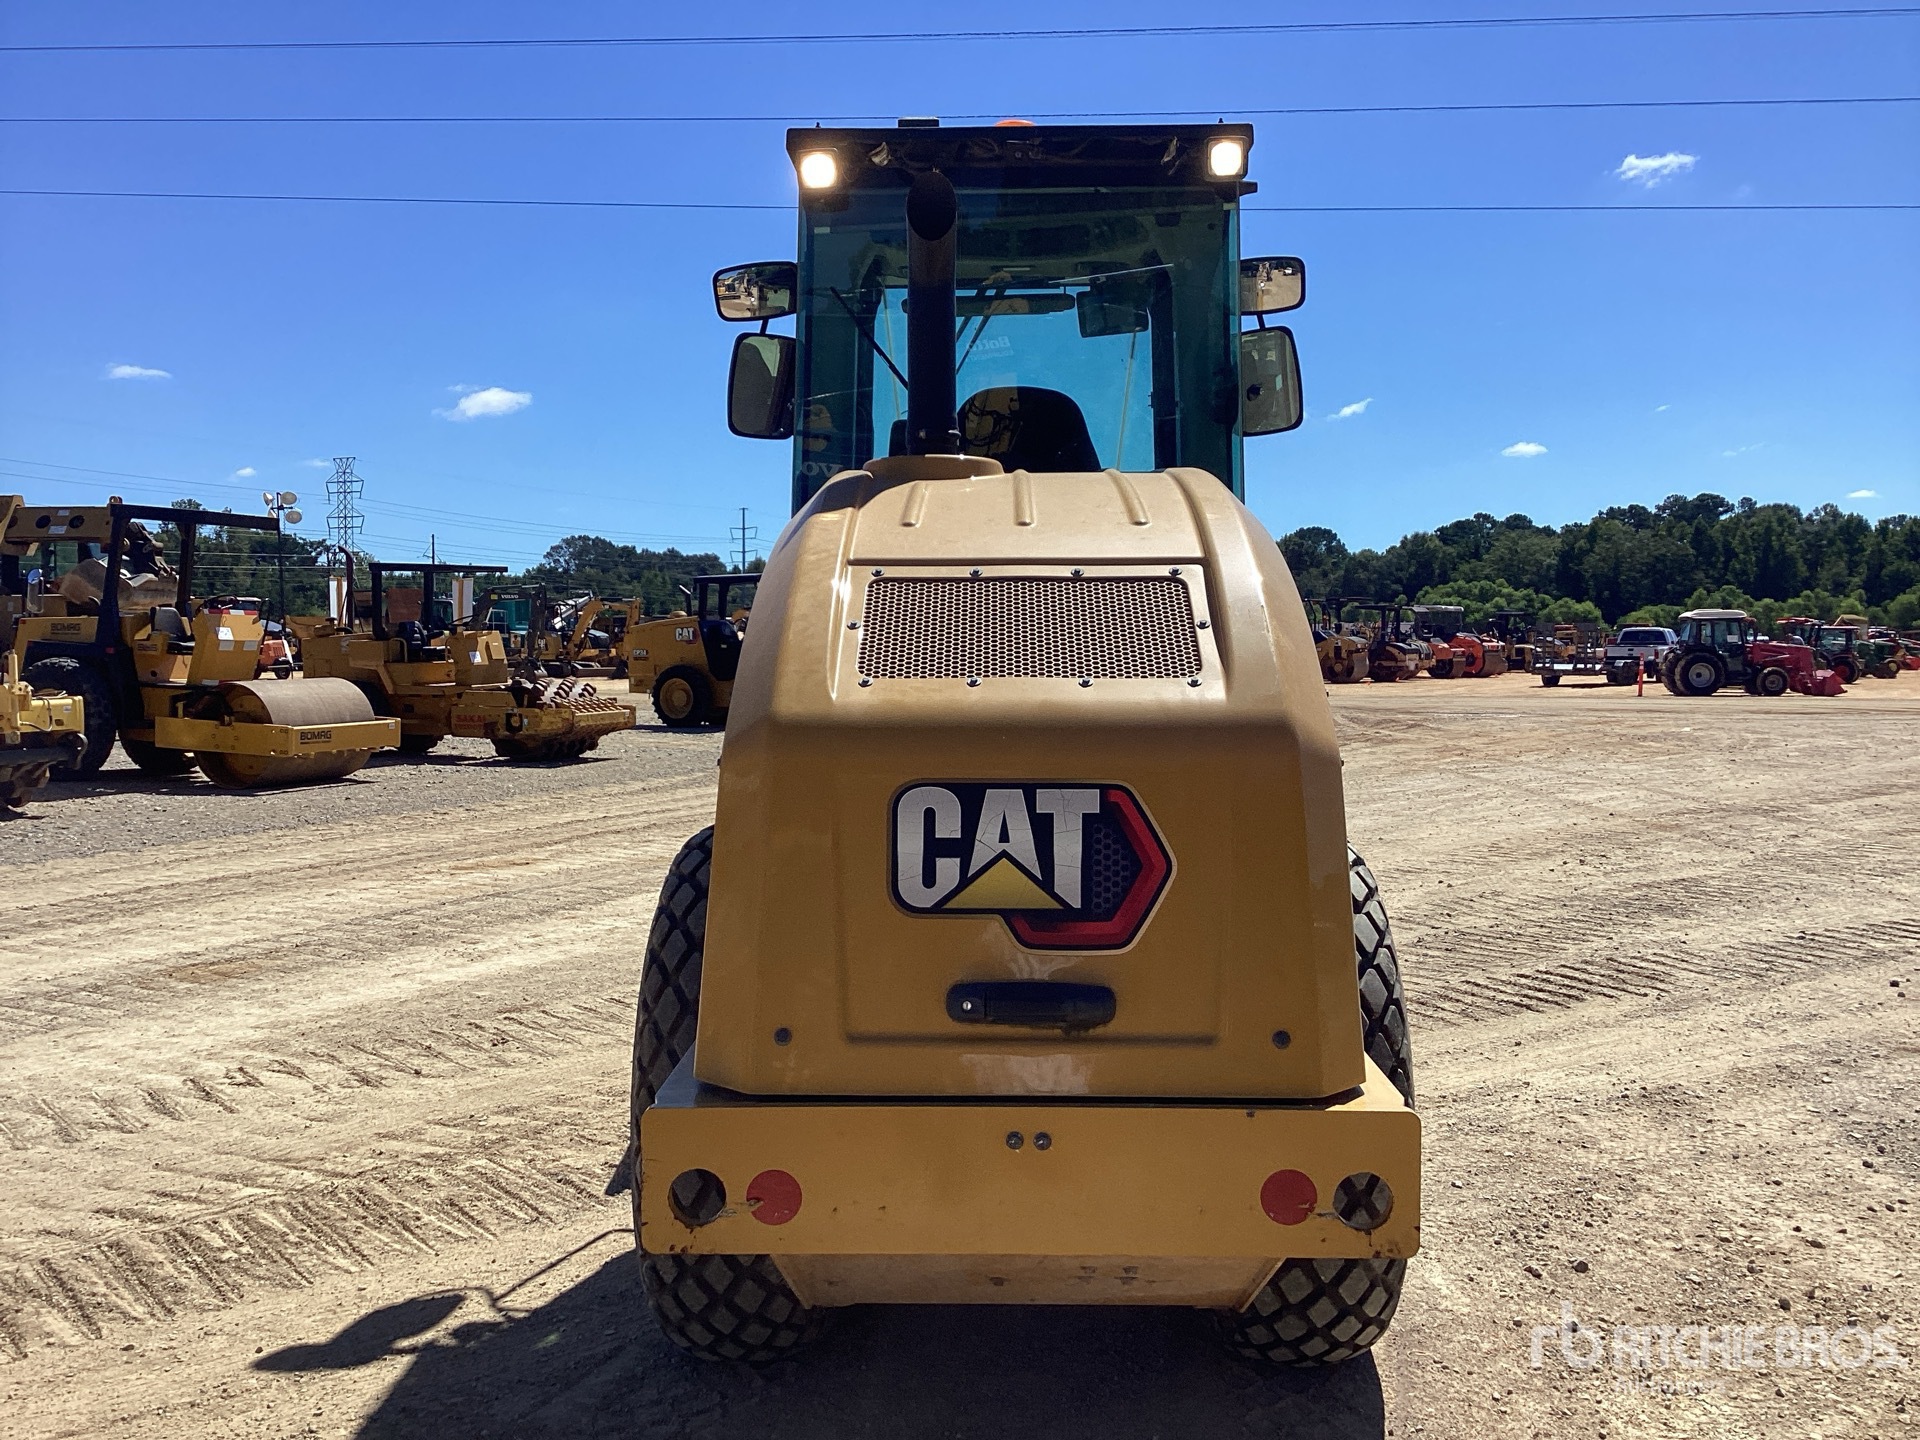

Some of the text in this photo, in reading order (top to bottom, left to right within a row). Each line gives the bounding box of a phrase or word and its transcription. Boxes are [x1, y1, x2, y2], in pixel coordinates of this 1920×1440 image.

[50, 622, 81, 632] BOMAG
[675, 627, 694, 641] CAT
[300, 730, 332, 741] BOMAG
[896, 786, 1101, 909] CAT
